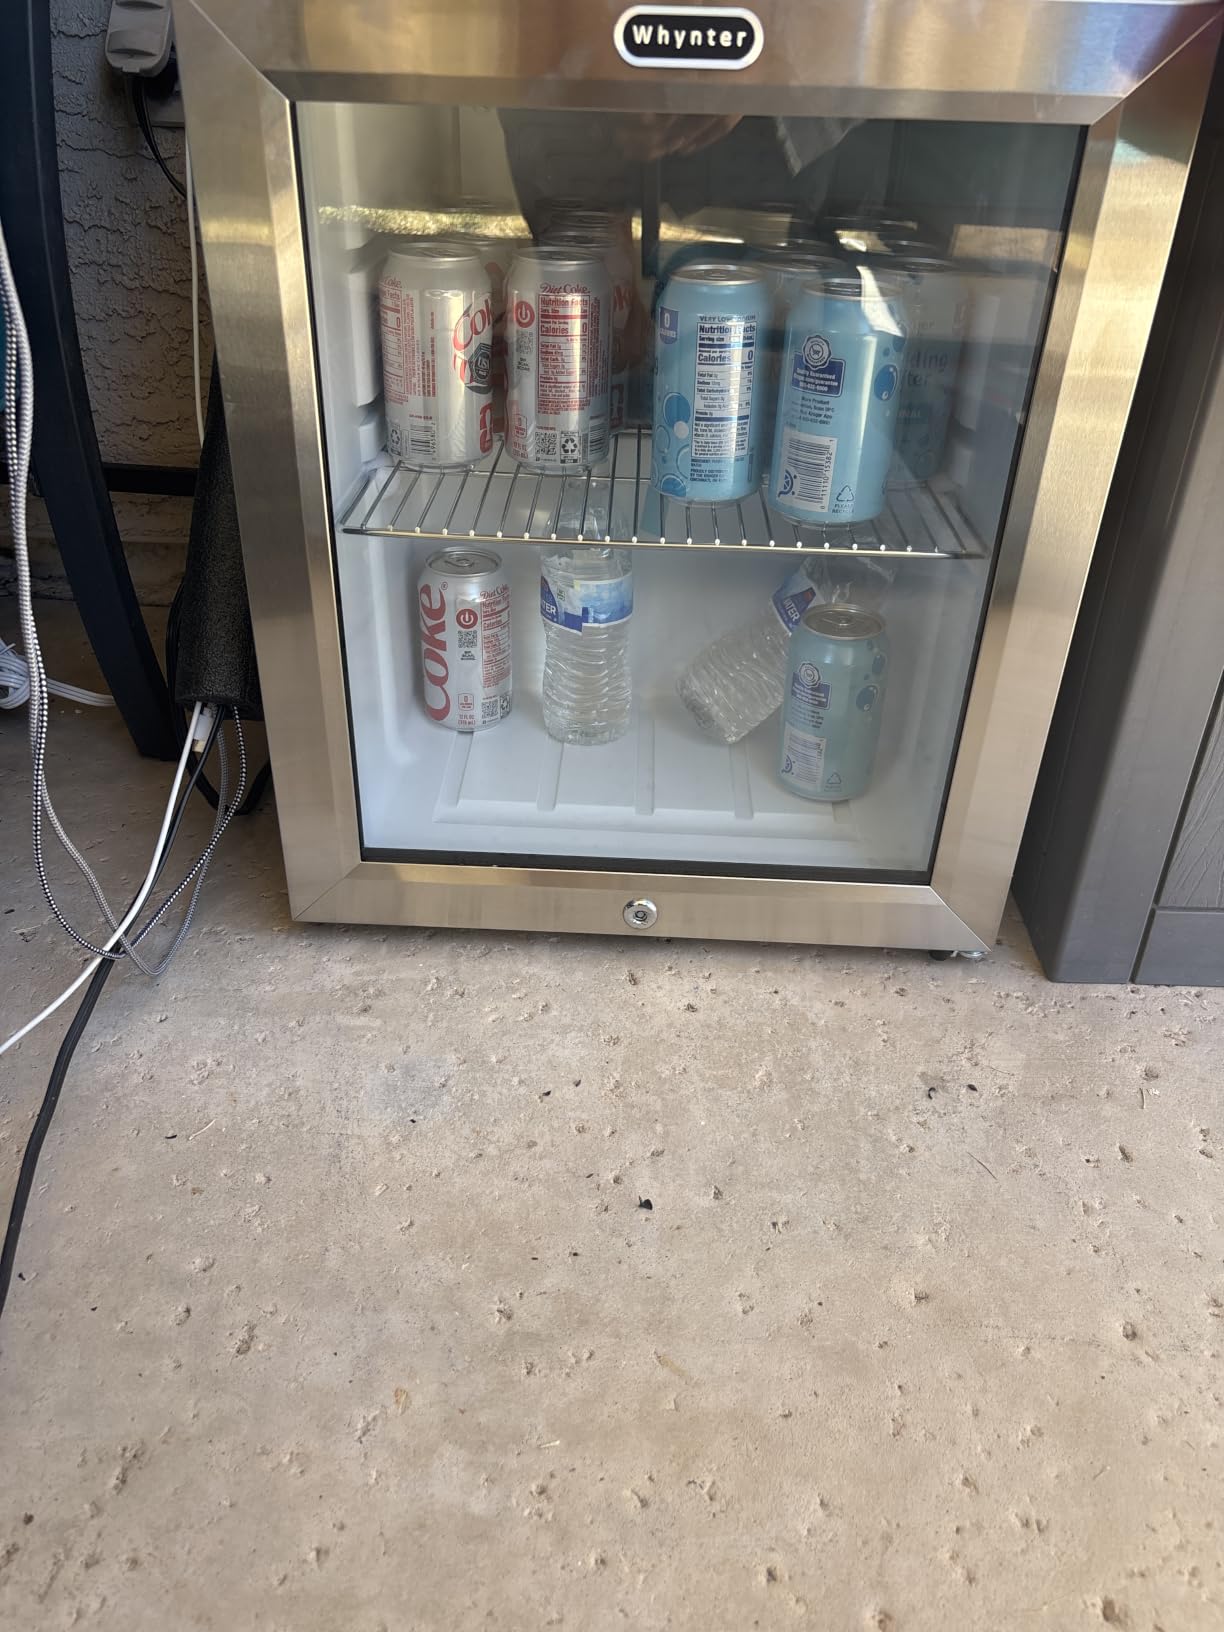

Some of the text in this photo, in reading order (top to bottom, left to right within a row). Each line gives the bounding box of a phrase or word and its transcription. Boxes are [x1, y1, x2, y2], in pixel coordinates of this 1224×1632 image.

[632, 24, 747, 49] Whynter
[540, 283, 589, 294] Diet Coke
[541, 297, 569, 306] Nutrition
[664, 313, 671, 328] 0
[540, 322, 588, 335] Calories 0
[698, 350, 753, 362] Calories 0
[824, 451, 833, 473] 15382
[820, 476, 830, 497] 11110
[420, 583, 451, 722] Coke
